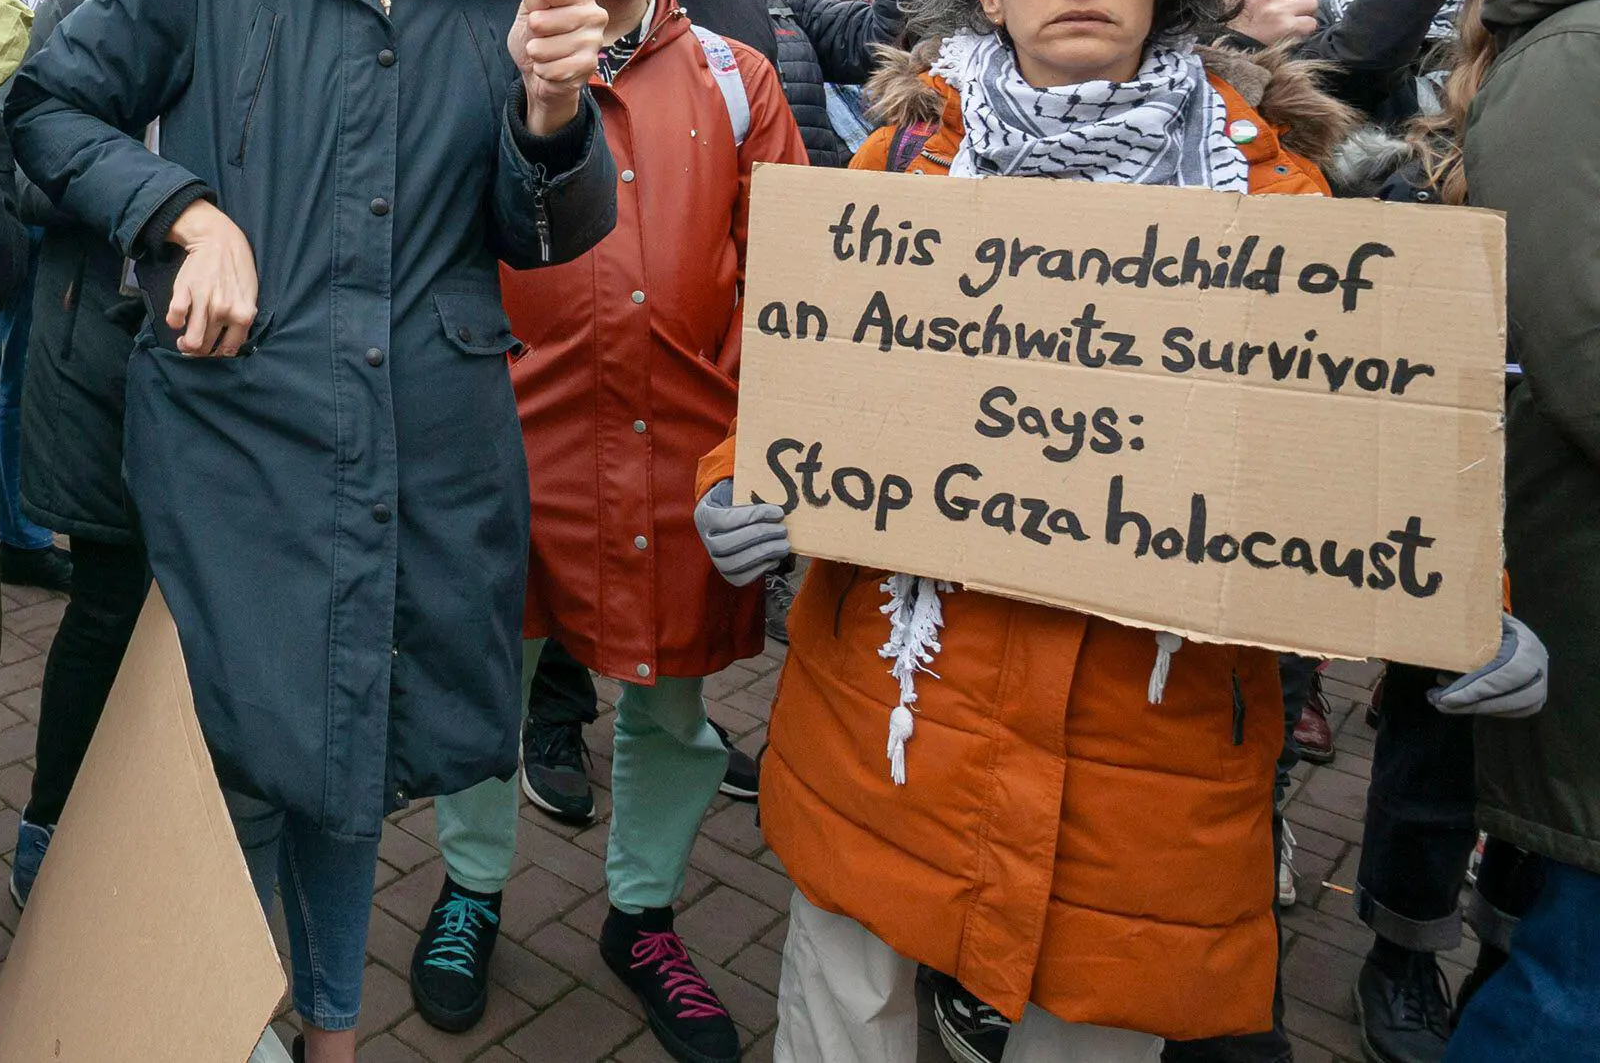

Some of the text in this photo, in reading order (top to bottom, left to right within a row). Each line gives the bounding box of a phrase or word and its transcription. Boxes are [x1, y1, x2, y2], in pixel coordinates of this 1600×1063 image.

[829, 202, 1396, 313] this grandchild of
[757, 299, 828, 342] an
[852, 289, 1144, 369] Auschwitz
[975, 384, 1146, 464] Says:
[751, 437, 1444, 599] Stop Gaza holocaust
